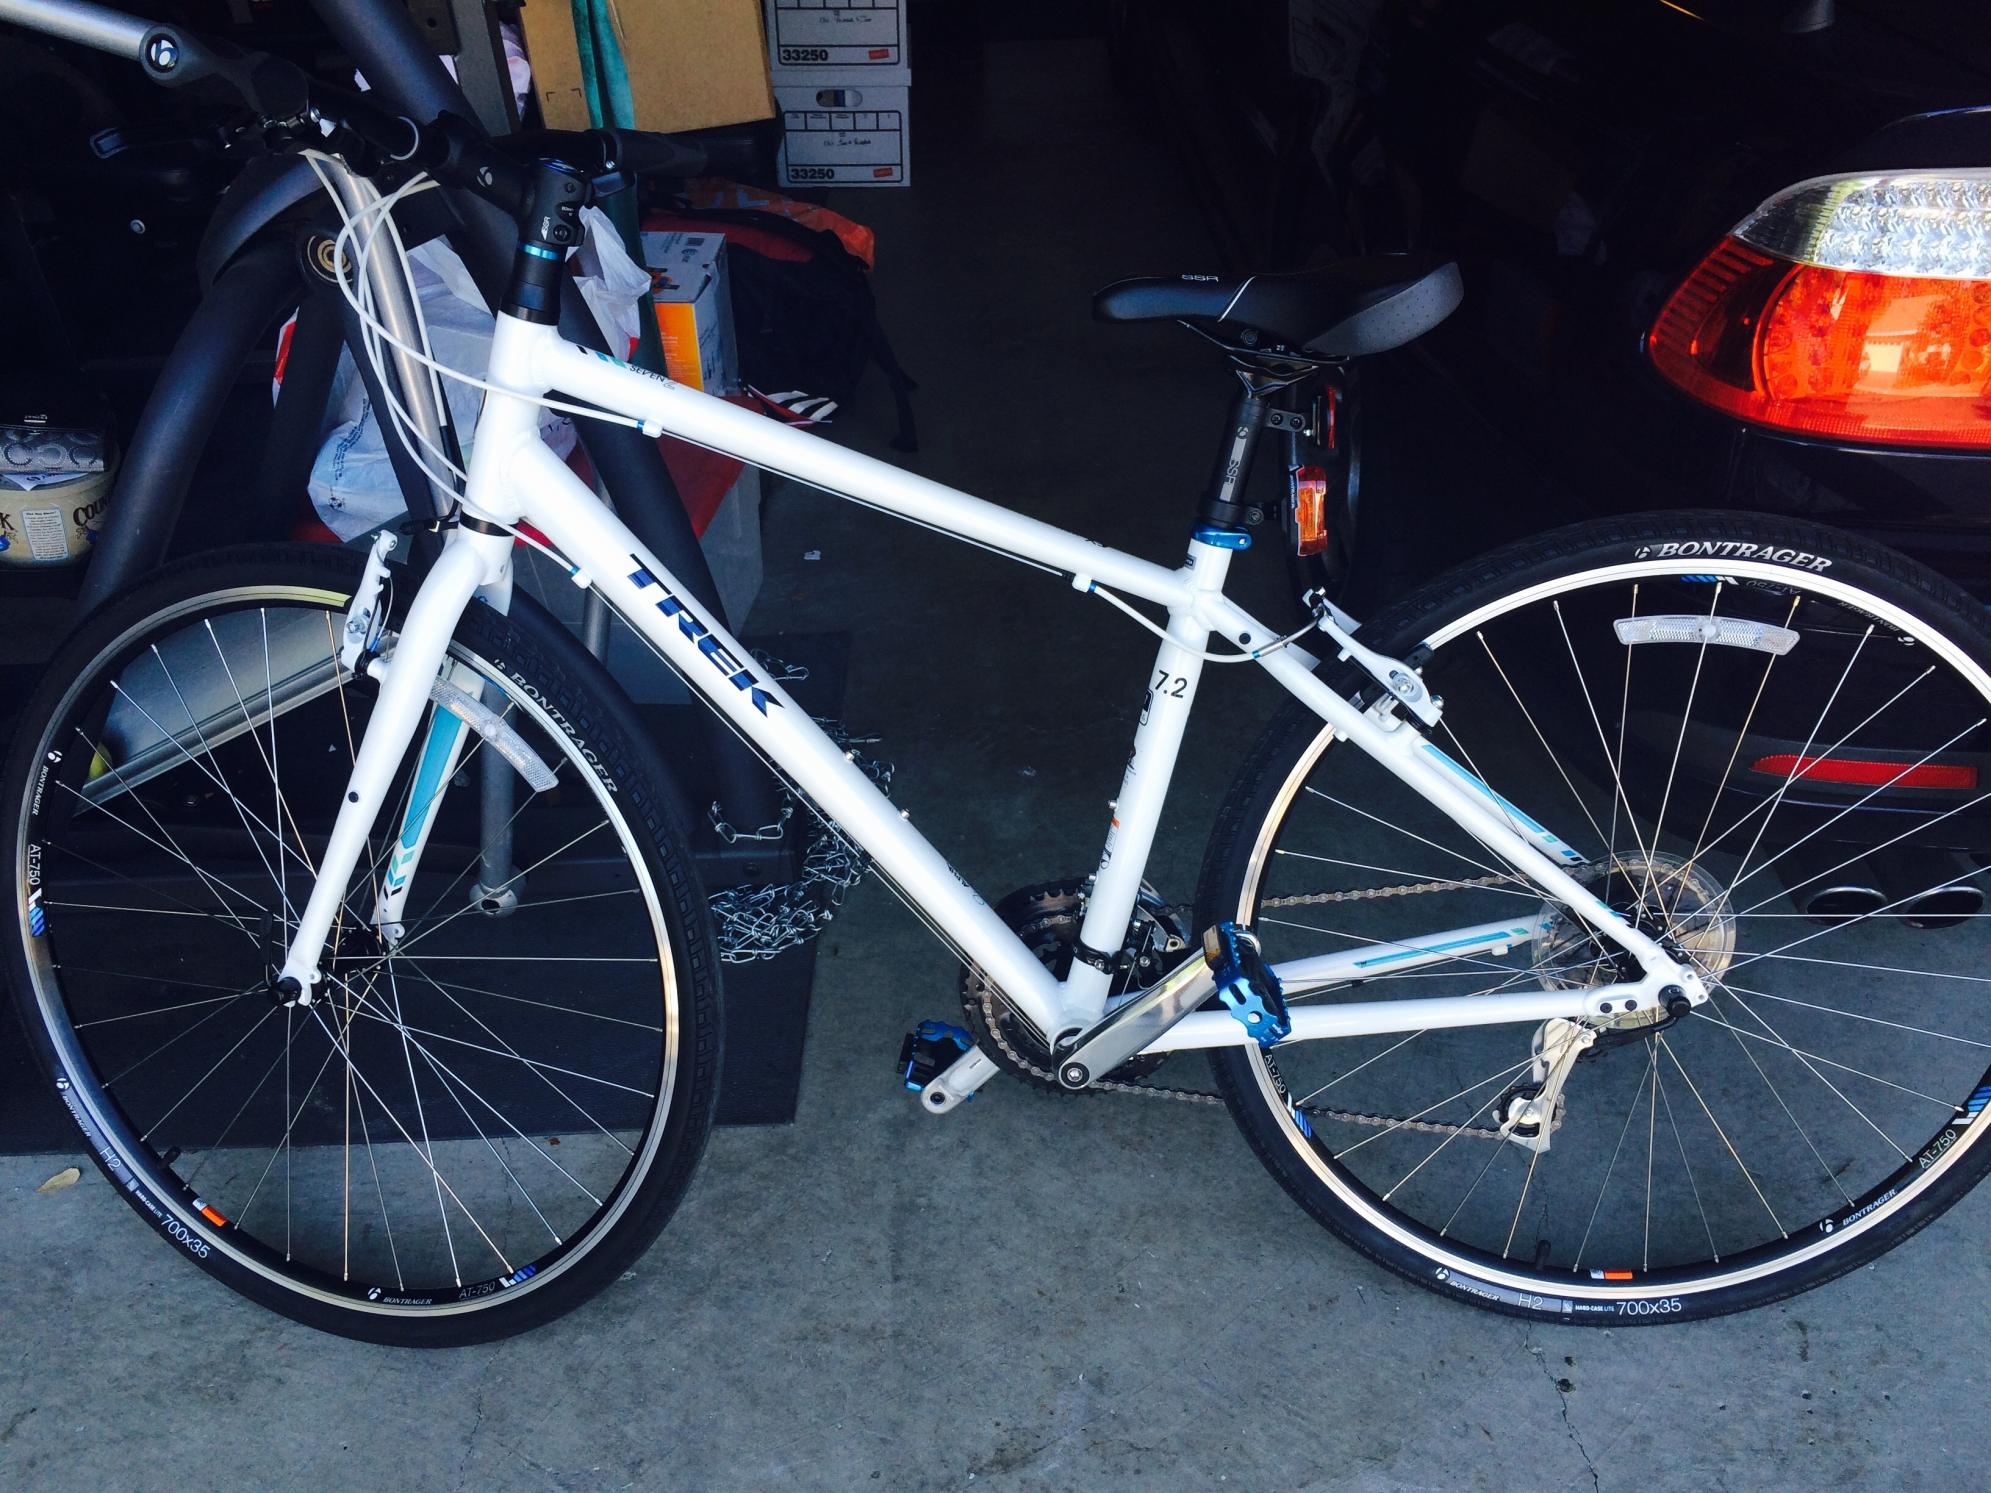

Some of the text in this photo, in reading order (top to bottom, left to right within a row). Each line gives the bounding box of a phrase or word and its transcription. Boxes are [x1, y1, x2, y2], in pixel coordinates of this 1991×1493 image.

[782, 49, 829, 62] 33250
[790, 168, 835, 180] 33250
[629, 364, 667, 383] SEVEN
[1656, 541, 1834, 573] BONTRAGER
[627, 553, 785, 718] TREK
[1154, 669, 1188, 699] 7.2
[510, 672, 618, 793] BONTRAGER
[31, 765, 49, 816] BONTRAGER
[29, 843, 42, 886] AT-750
[1265, 1054, 1286, 1095] AT-750
[62, 1095, 92, 1138] BONTRAGER
[100, 1146, 121, 1172] H2
[161, 1213, 211, 1259] 700x35
[1842, 1129, 1957, 1226] BONTRAGER AT-750
[382, 1281, 496, 1305] BONTRAGER AT-750
[1450, 1280, 1501, 1301] BONTRAGER
[1517, 1292, 1543, 1311] H2
[1575, 1304, 1603, 1313] HARD-CASE
[1616, 1298, 1682, 1316] 700x35
